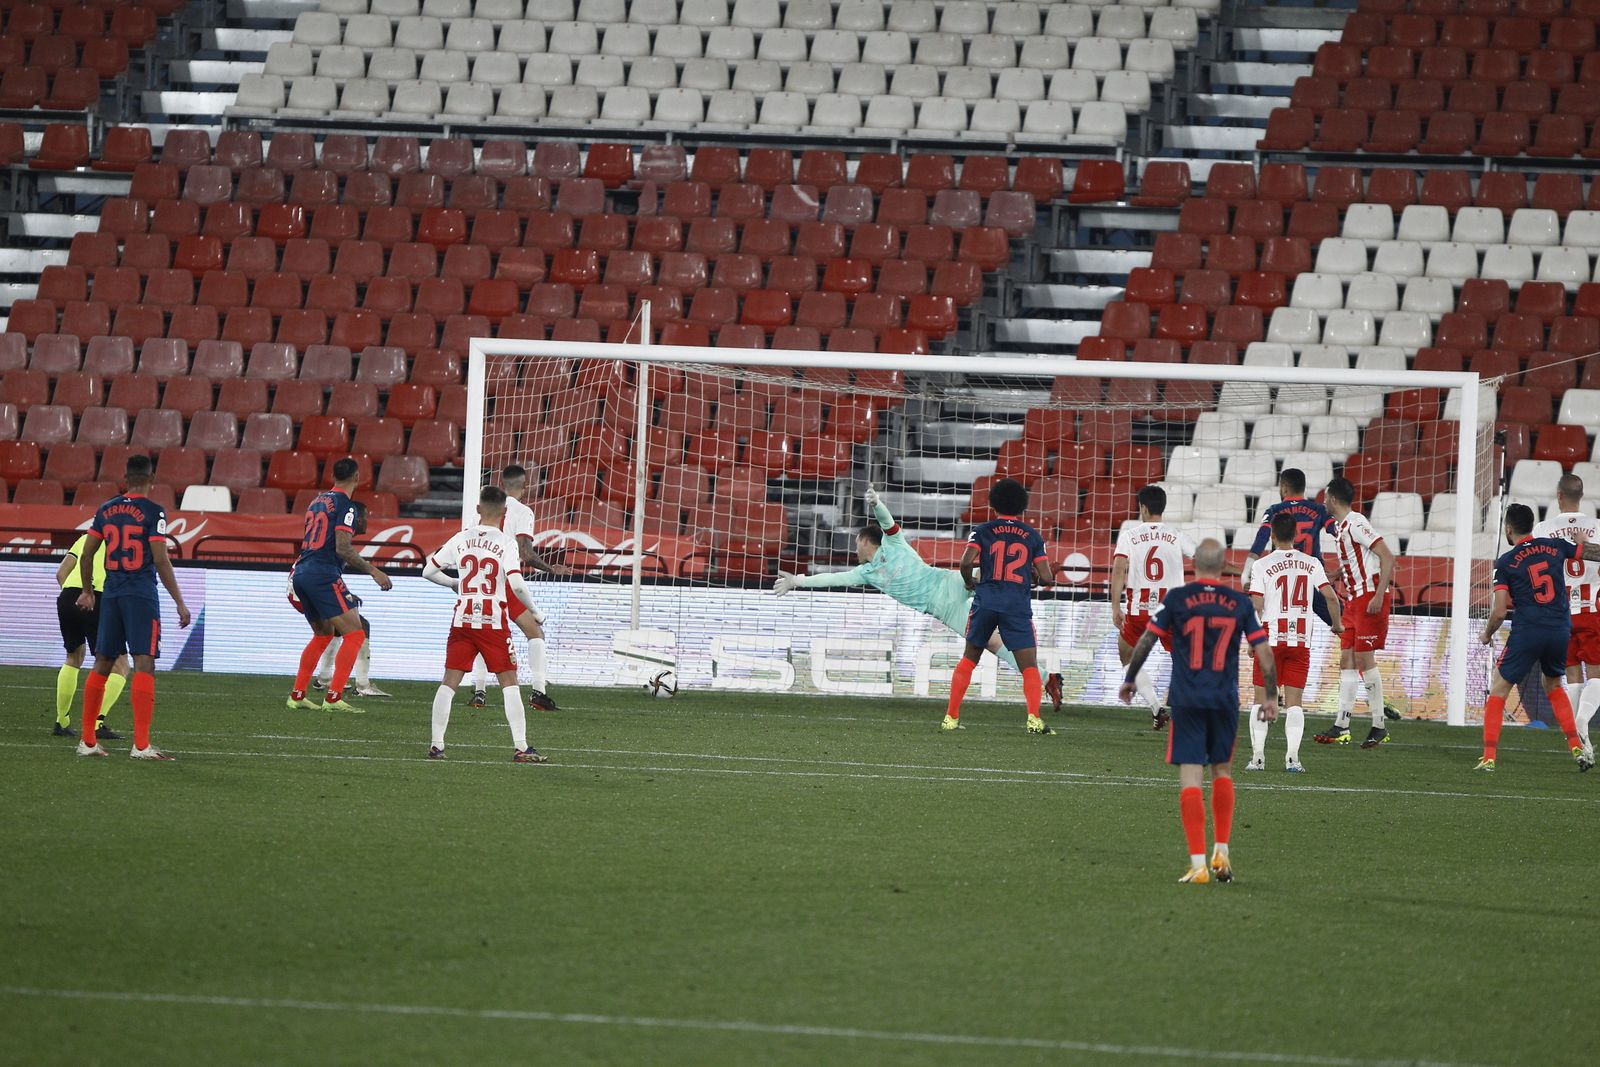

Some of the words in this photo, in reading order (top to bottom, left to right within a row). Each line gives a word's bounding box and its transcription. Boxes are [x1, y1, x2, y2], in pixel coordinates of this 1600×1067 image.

[103, 504, 145, 522] FERNANDO
[301, 511, 328, 550] 20
[103, 524, 144, 571] 25
[456, 545, 465, 554] F.
[466, 539, 505, 559] VILLALBA
[992, 525, 1030, 540] KOUNDE
[1294, 521, 1314, 556] 5
[460, 554, 499, 596] 23
[989, 540, 1028, 583] 12
[1143, 545, 1164, 582] 6
[1266, 559, 1316, 578] ROBERTONE
[1184, 592, 1217, 610] ALEIX
[1275, 574, 1308, 614] 14
[1527, 560, 1556, 604] 5
[1183, 615, 1237, 672] 17
